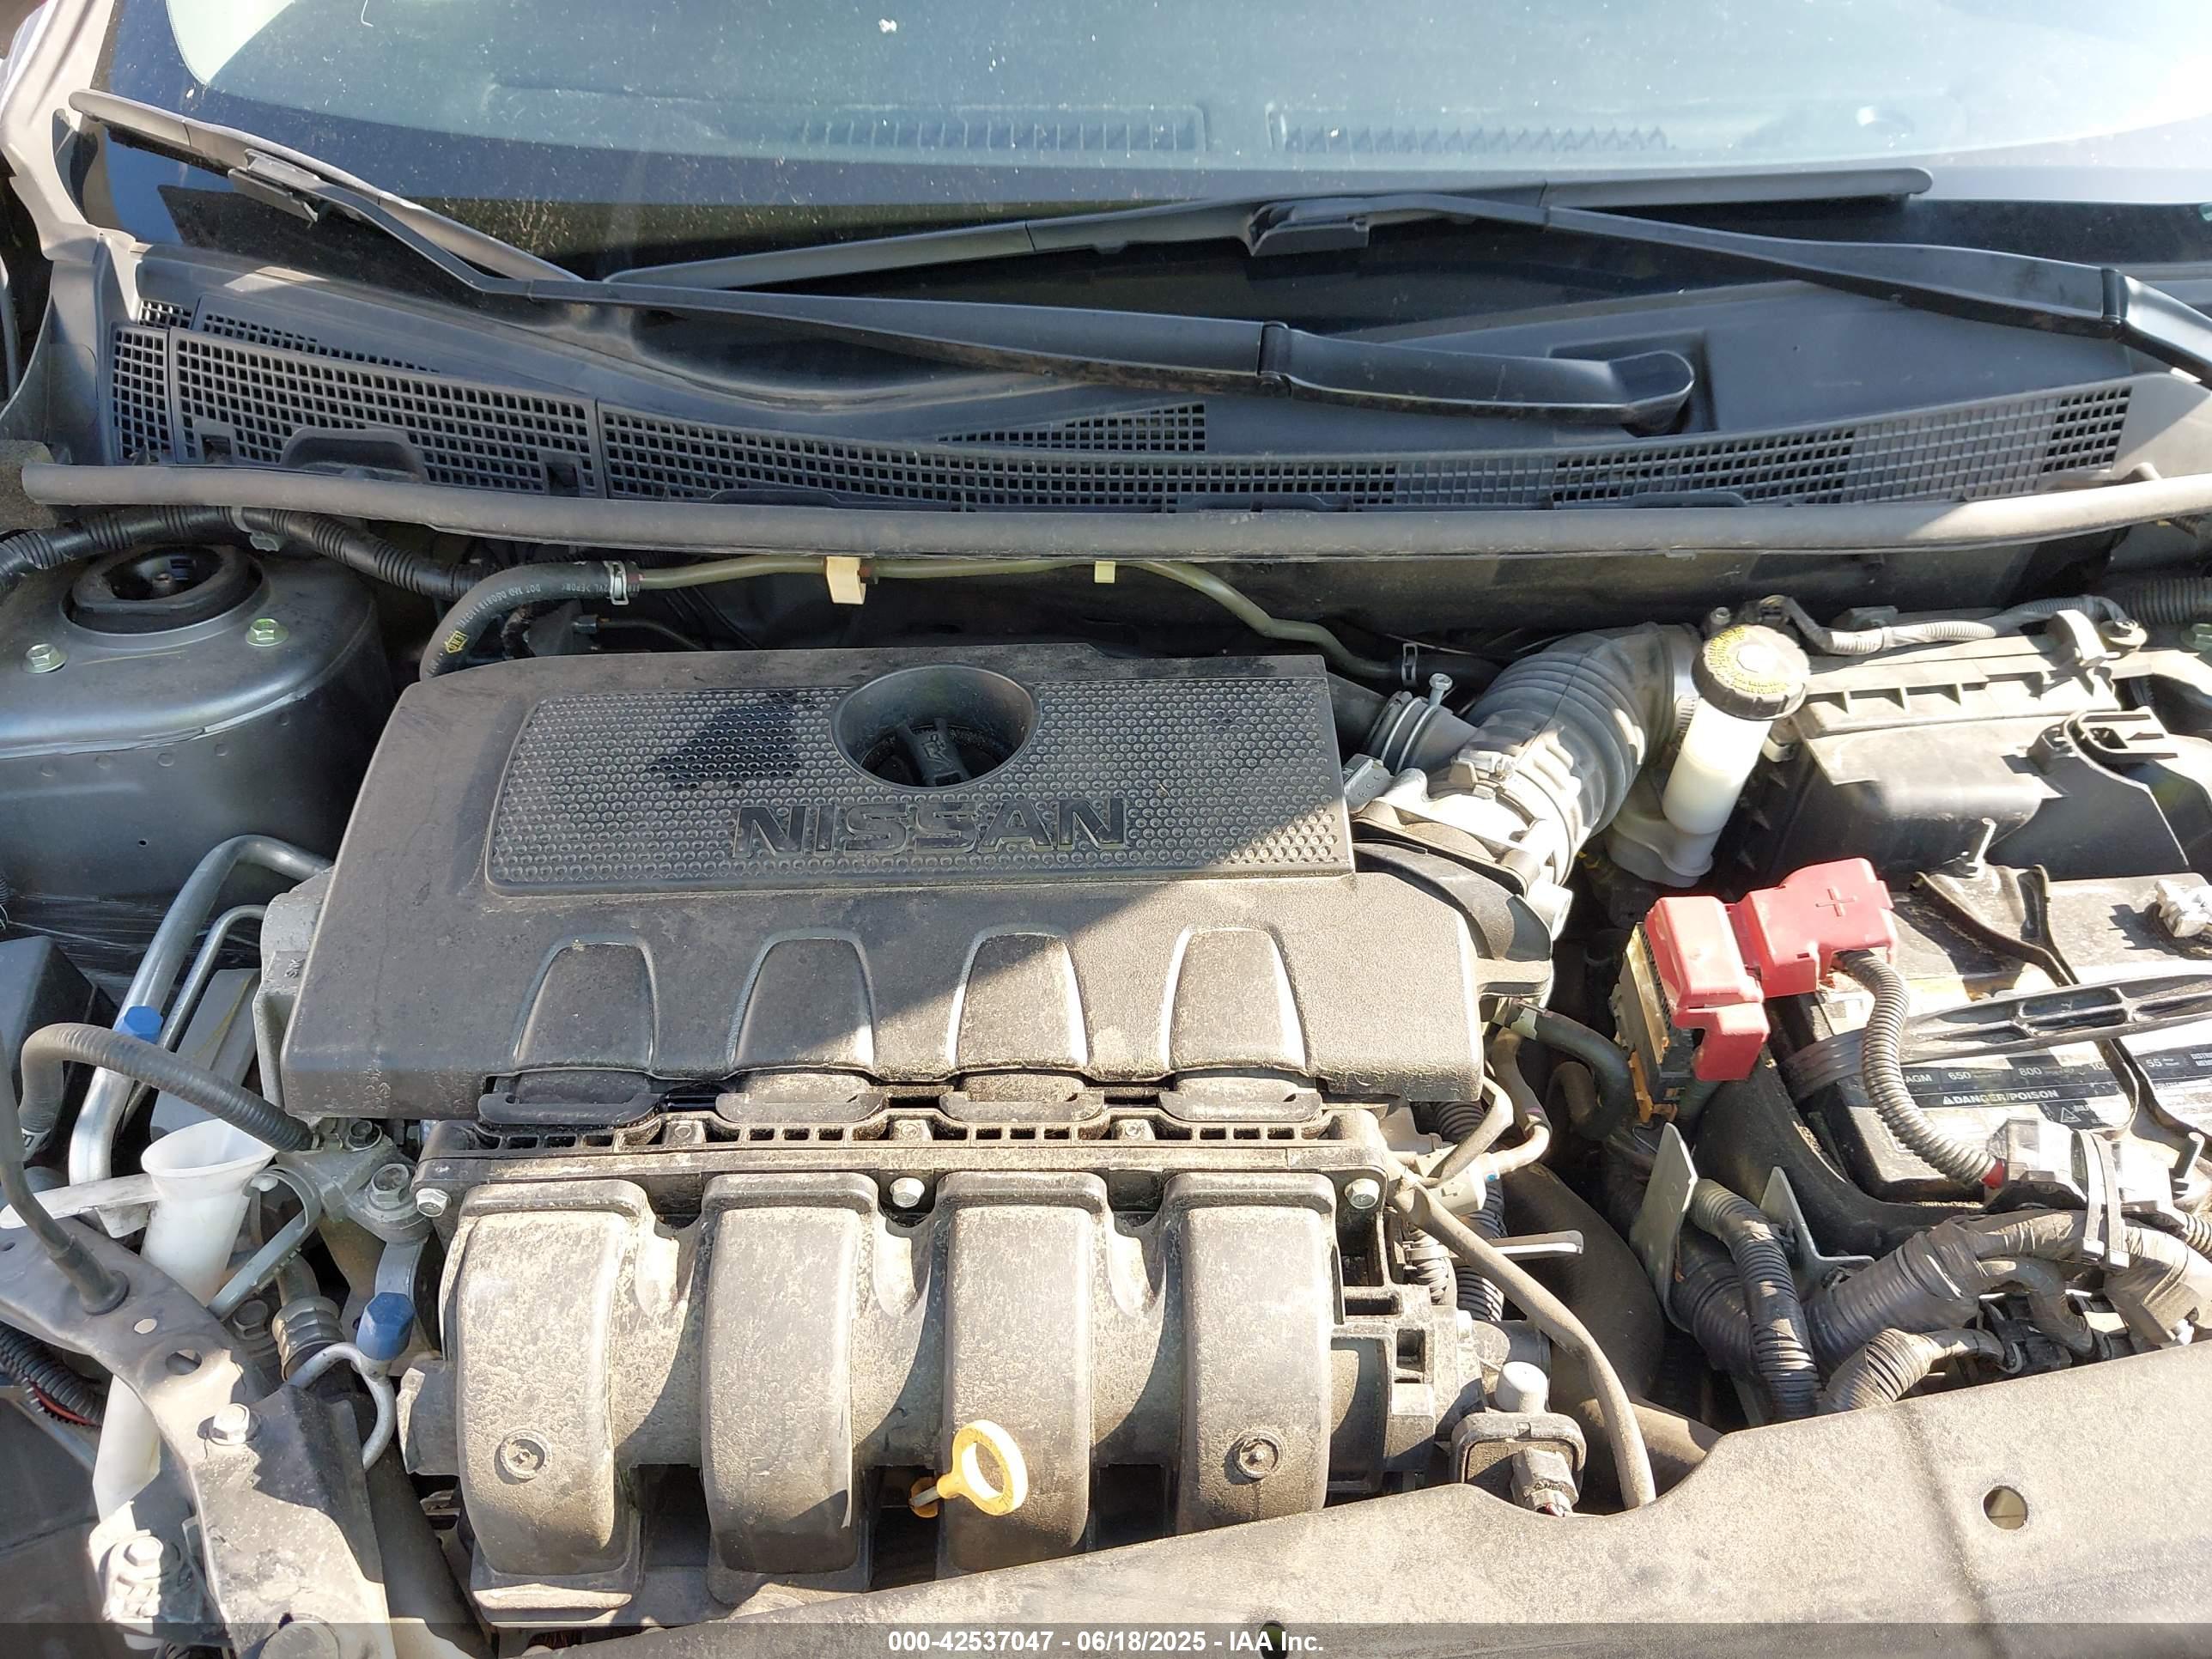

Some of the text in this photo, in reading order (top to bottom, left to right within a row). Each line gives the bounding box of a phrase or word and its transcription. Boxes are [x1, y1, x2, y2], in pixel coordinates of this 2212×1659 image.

[732, 798, 1127, 859] NISSAN
[2146, 1058, 2163, 1067] 55
[1948, 1071, 1972, 1080] 650
[2018, 1066, 2042, 1076] 800
[1905, 1073, 1932, 1083] AGM
[1952, 1089, 2059, 1105] DANGER/POISON
